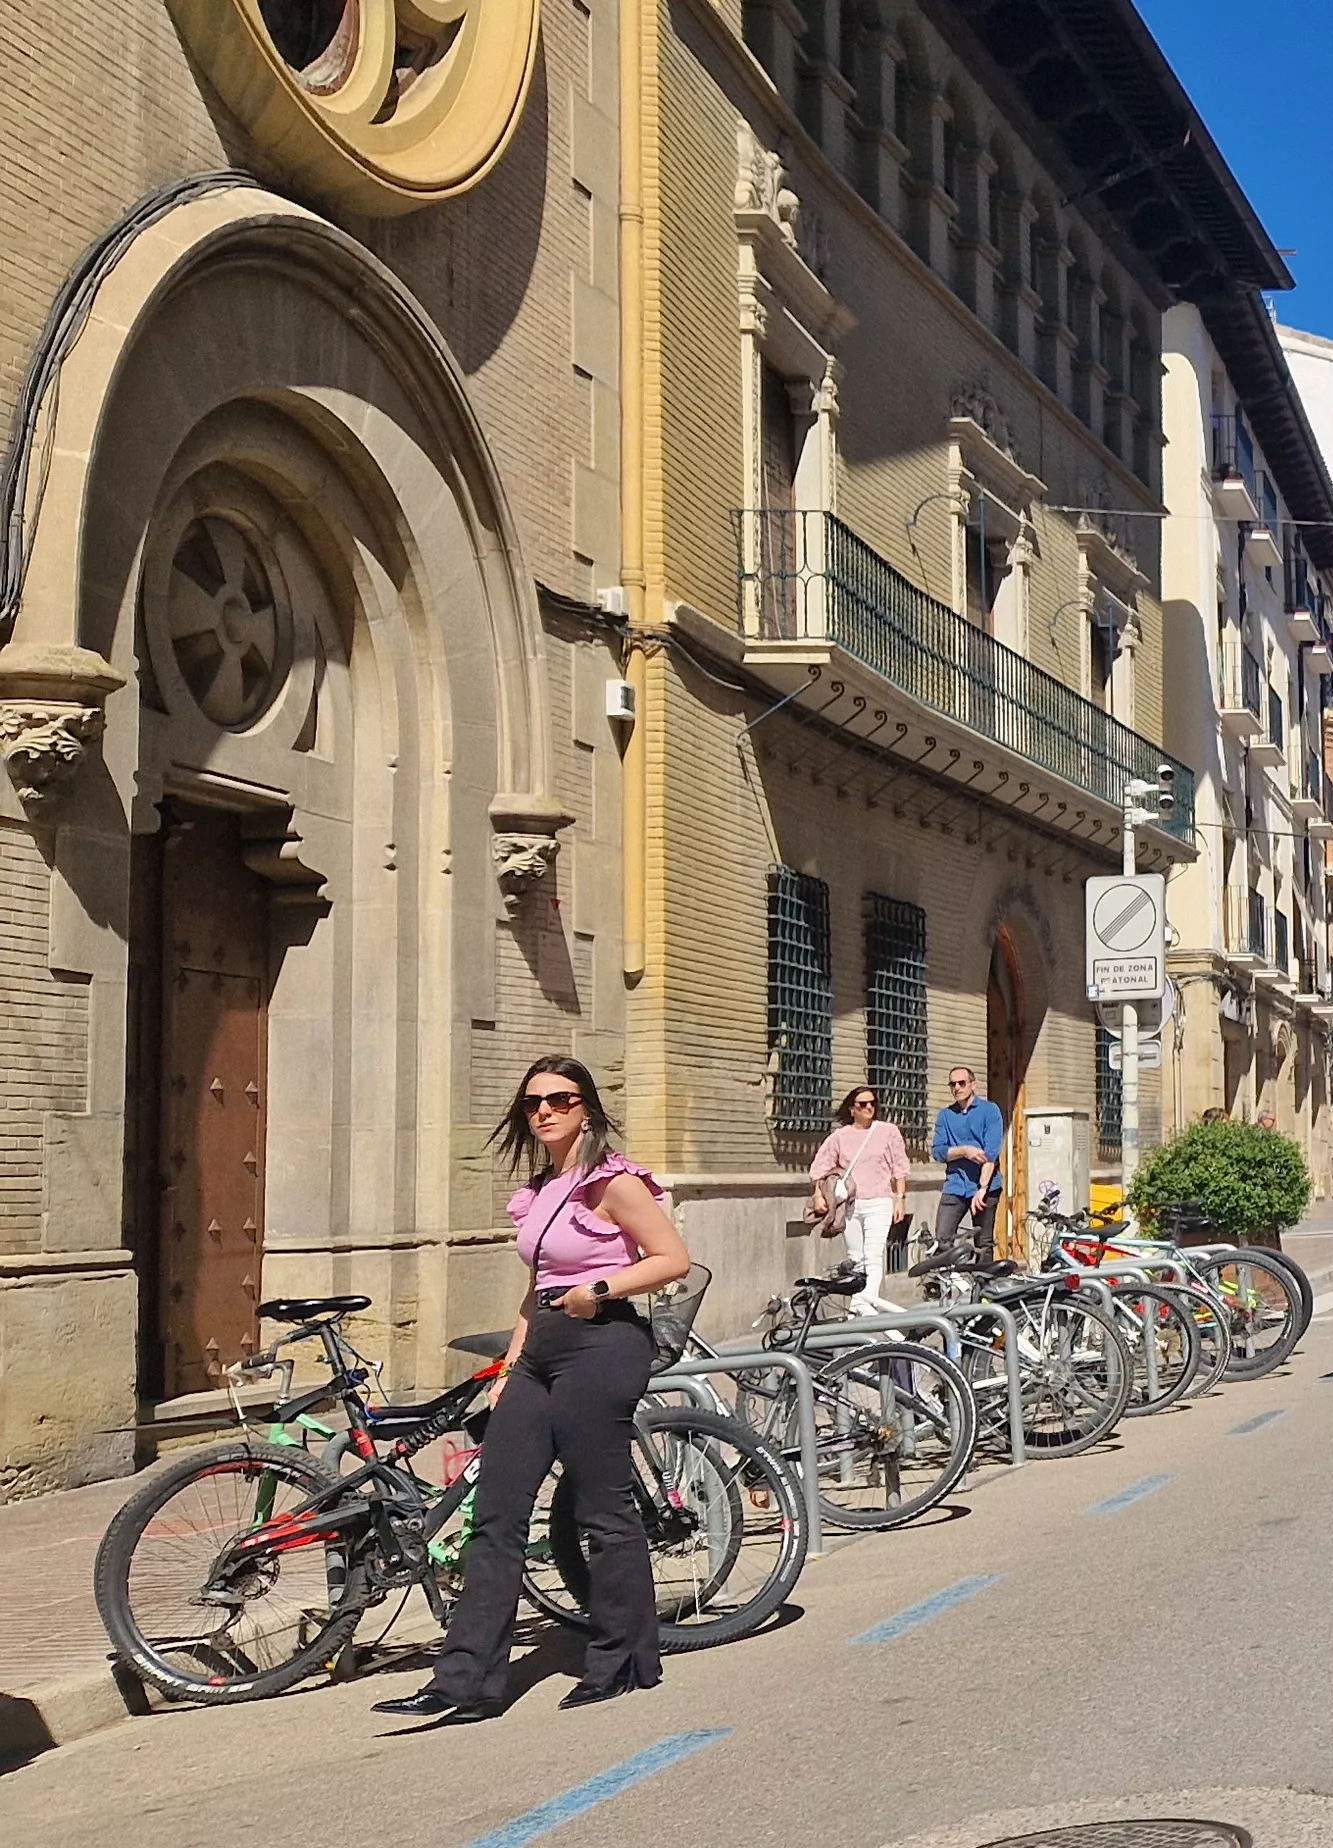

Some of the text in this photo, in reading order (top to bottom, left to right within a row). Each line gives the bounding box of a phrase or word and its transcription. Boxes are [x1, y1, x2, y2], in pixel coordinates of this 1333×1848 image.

[1096, 964, 1154, 974] FIN DE ZONA
